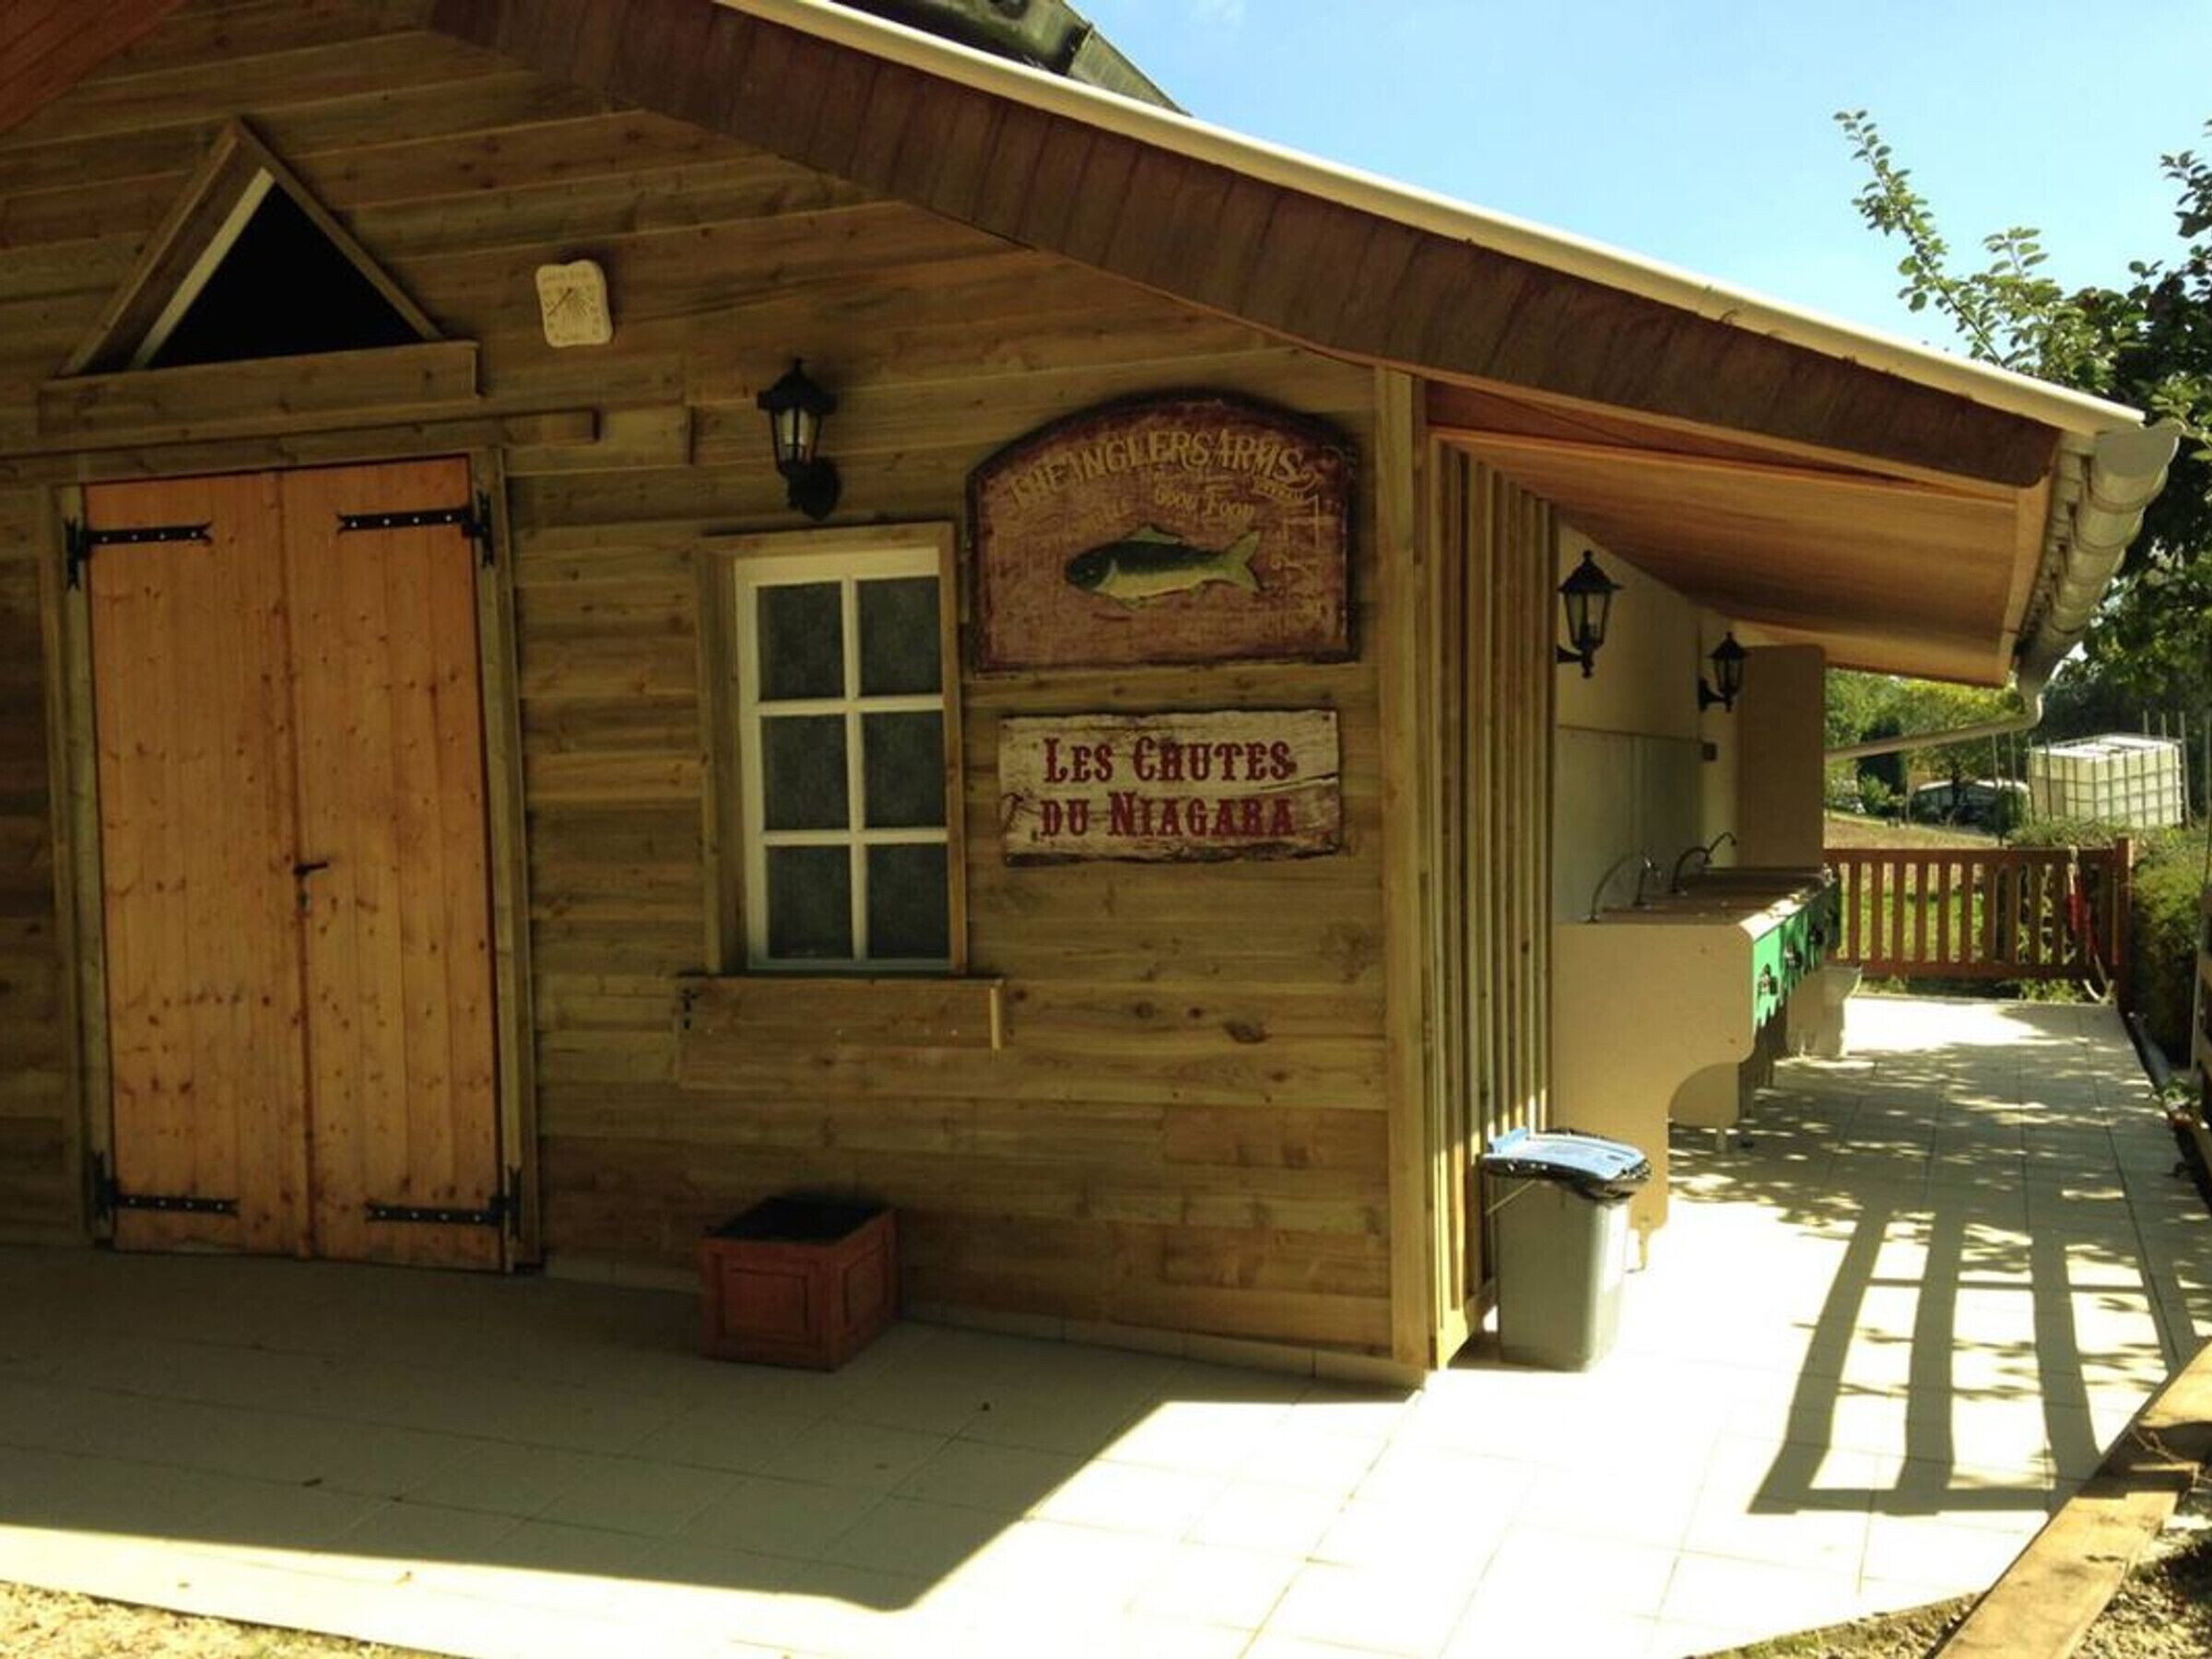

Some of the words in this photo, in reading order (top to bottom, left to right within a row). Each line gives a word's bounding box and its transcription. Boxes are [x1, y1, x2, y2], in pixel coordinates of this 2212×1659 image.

[1211, 428, 1322, 492] ARMS
[1043, 738, 1114, 782] LES
[1133, 737, 1298, 782] CHUTES
[1041, 799, 1090, 837] DU
[1109, 791, 1297, 838] NIAGARA
